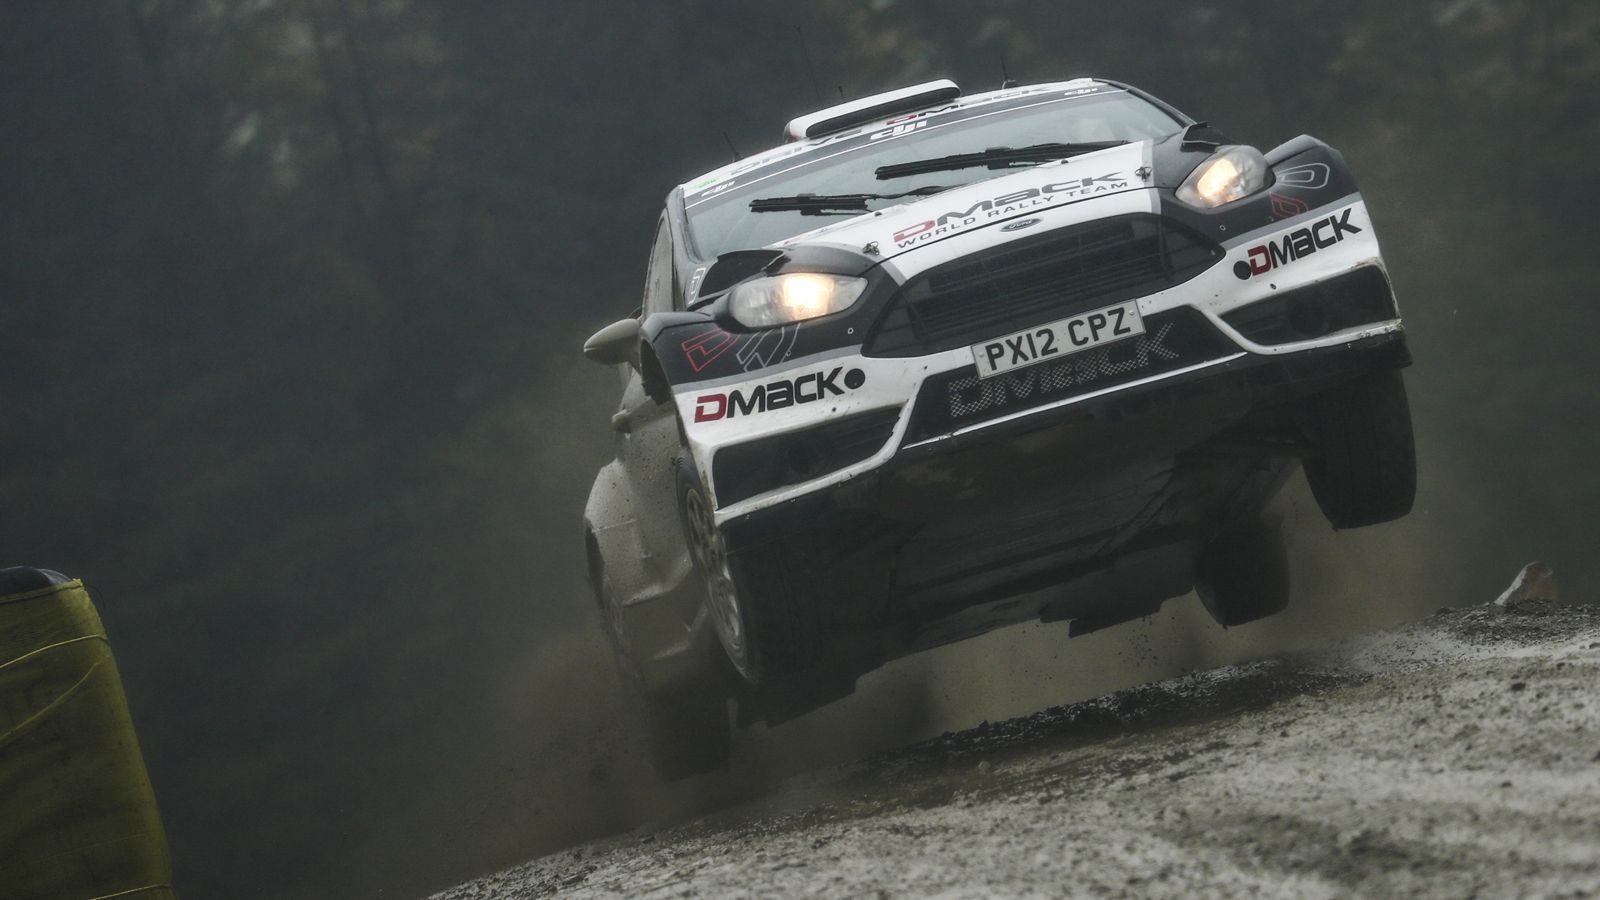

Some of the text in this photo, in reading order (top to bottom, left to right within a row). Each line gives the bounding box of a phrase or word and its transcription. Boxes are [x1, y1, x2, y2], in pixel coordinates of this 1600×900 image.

[897, 181, 1128, 249] WORLD RALLY TEAM
[985, 307, 1131, 371] PX12 CPZ
